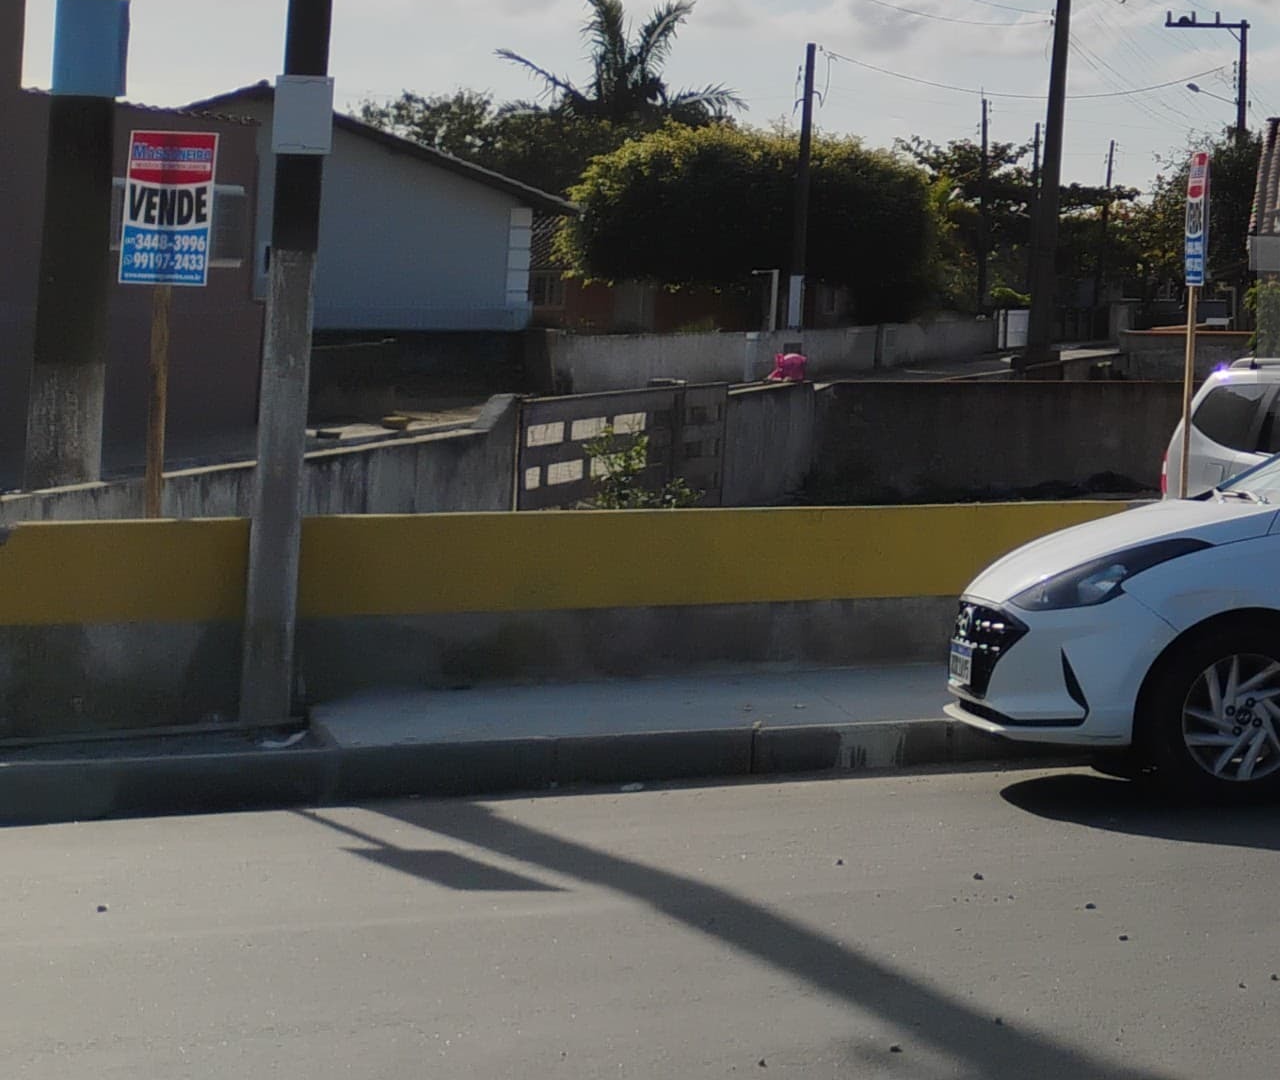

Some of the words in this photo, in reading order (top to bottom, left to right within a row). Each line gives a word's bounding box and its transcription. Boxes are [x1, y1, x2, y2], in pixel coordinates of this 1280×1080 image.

[129, 184, 209, 226] VENDE
[135, 233, 205, 252] 3448-3996
[133, 251, 204, 271] 99197-2433
